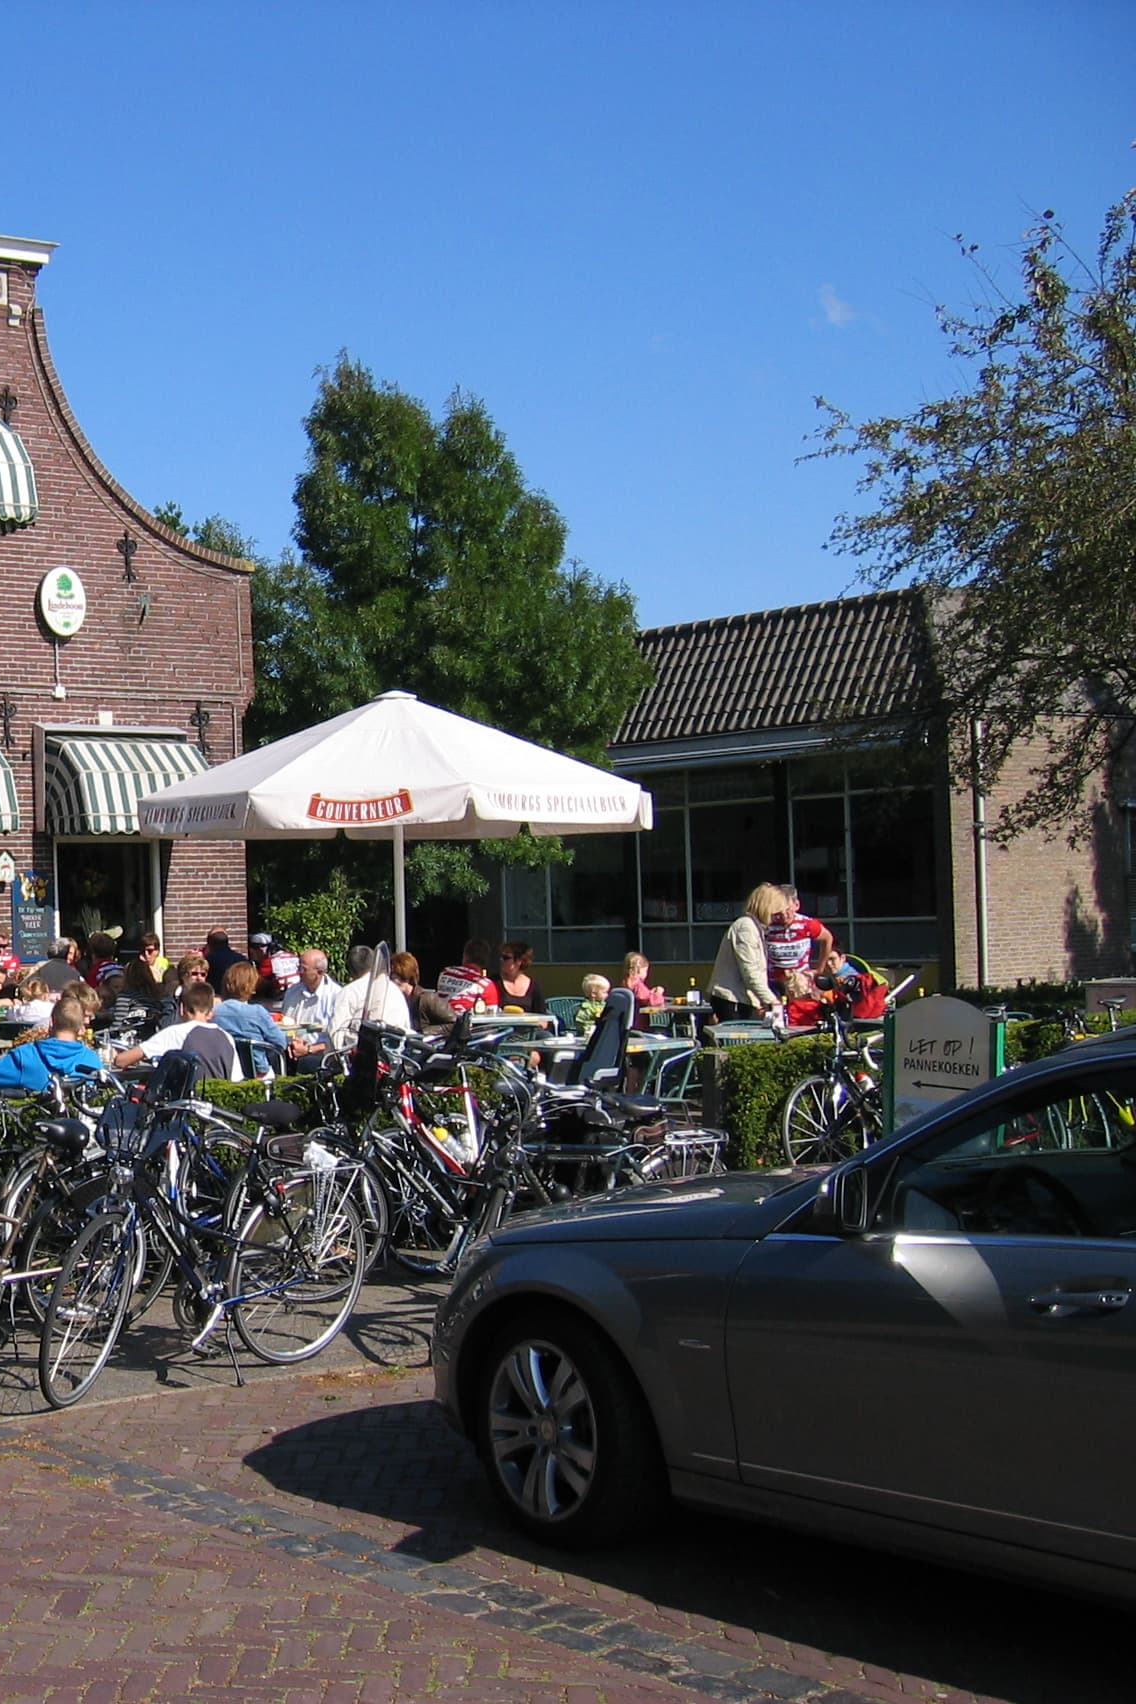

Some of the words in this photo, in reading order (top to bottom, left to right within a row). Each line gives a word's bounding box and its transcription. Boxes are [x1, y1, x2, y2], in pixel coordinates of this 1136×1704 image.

[316, 796, 403, 821] GOUVERNEUR
[488, 792, 541, 812] LIMBURGS
[909, 1038, 937, 1055] LET
[943, 1040, 962, 1056] OP
[904, 1057, 980, 1076] PANNEKOEKEN
